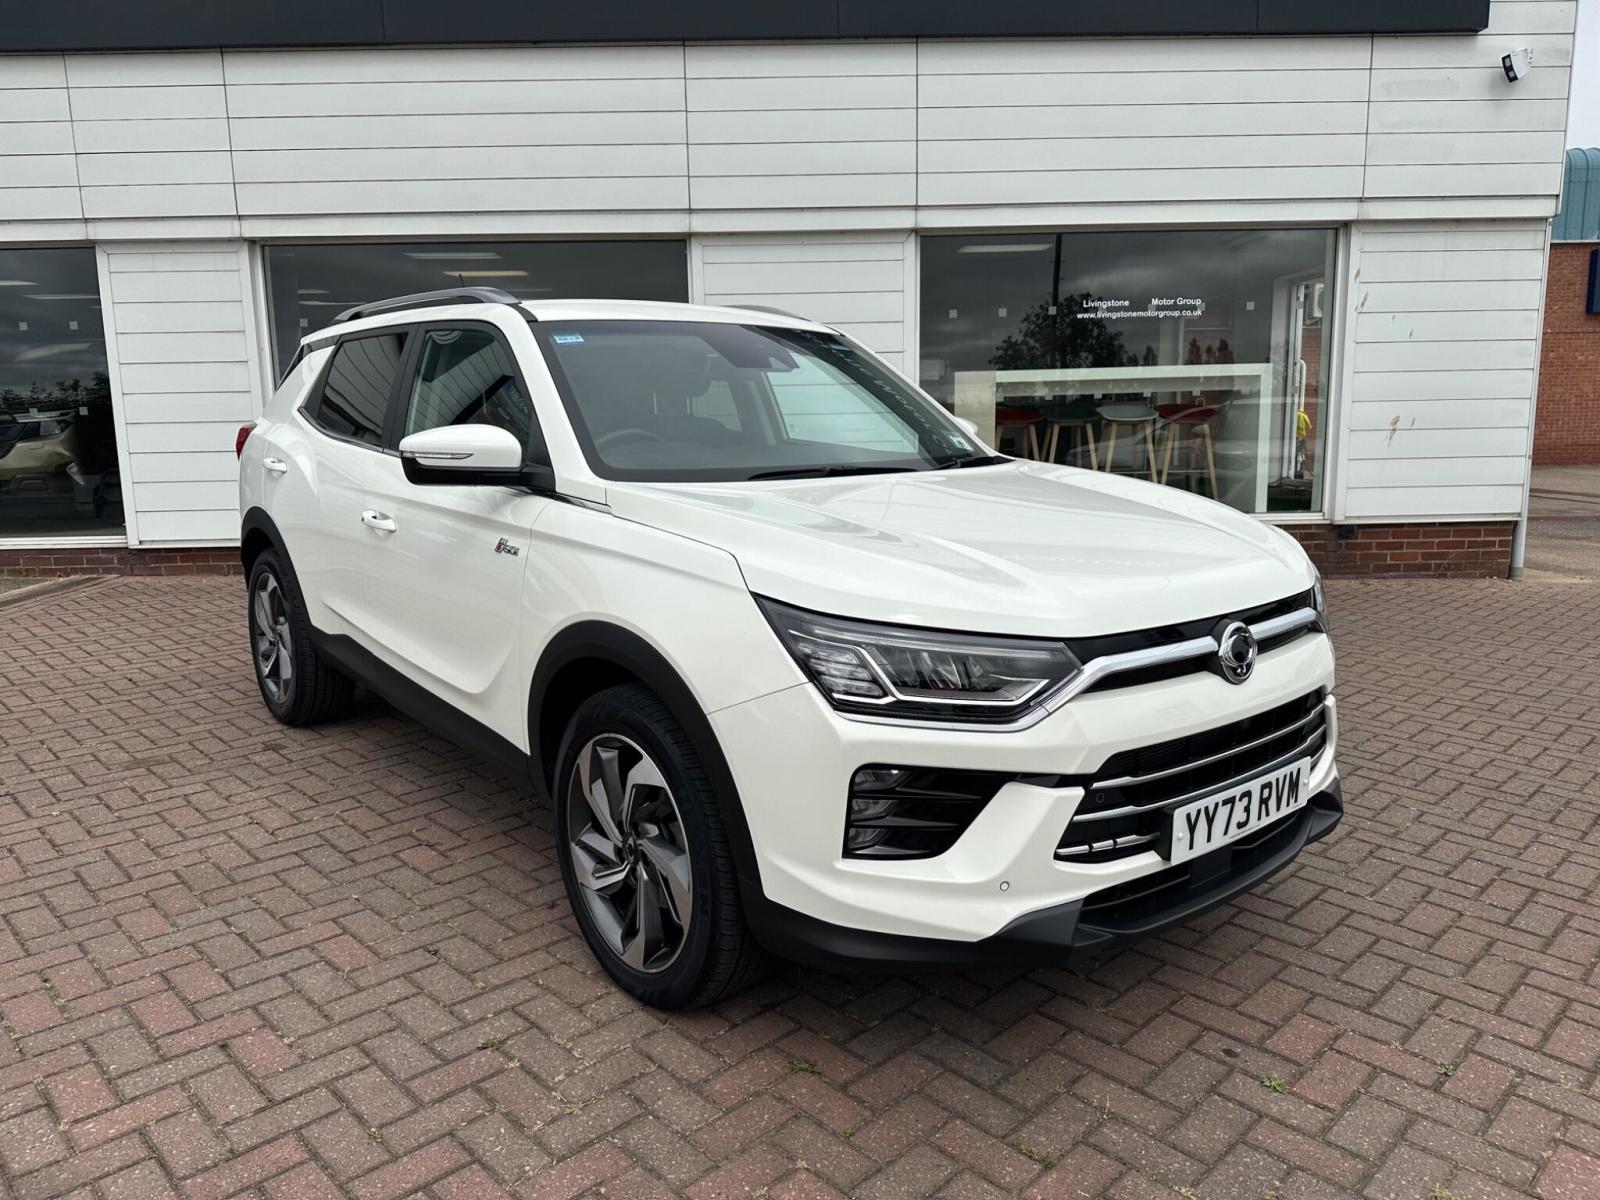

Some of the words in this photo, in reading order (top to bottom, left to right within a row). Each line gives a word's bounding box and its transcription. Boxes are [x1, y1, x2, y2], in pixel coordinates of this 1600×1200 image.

[1083, 299, 1130, 308] Livingstone
[1151, 298, 1175, 306] Motor
[1176, 297, 1202, 306] Group
[1076, 309, 1202, 319] www.livingstonemotorgroup.co.uk
[1185, 789, 1252, 851] YY73
[1257, 767, 1302, 822] RVM
